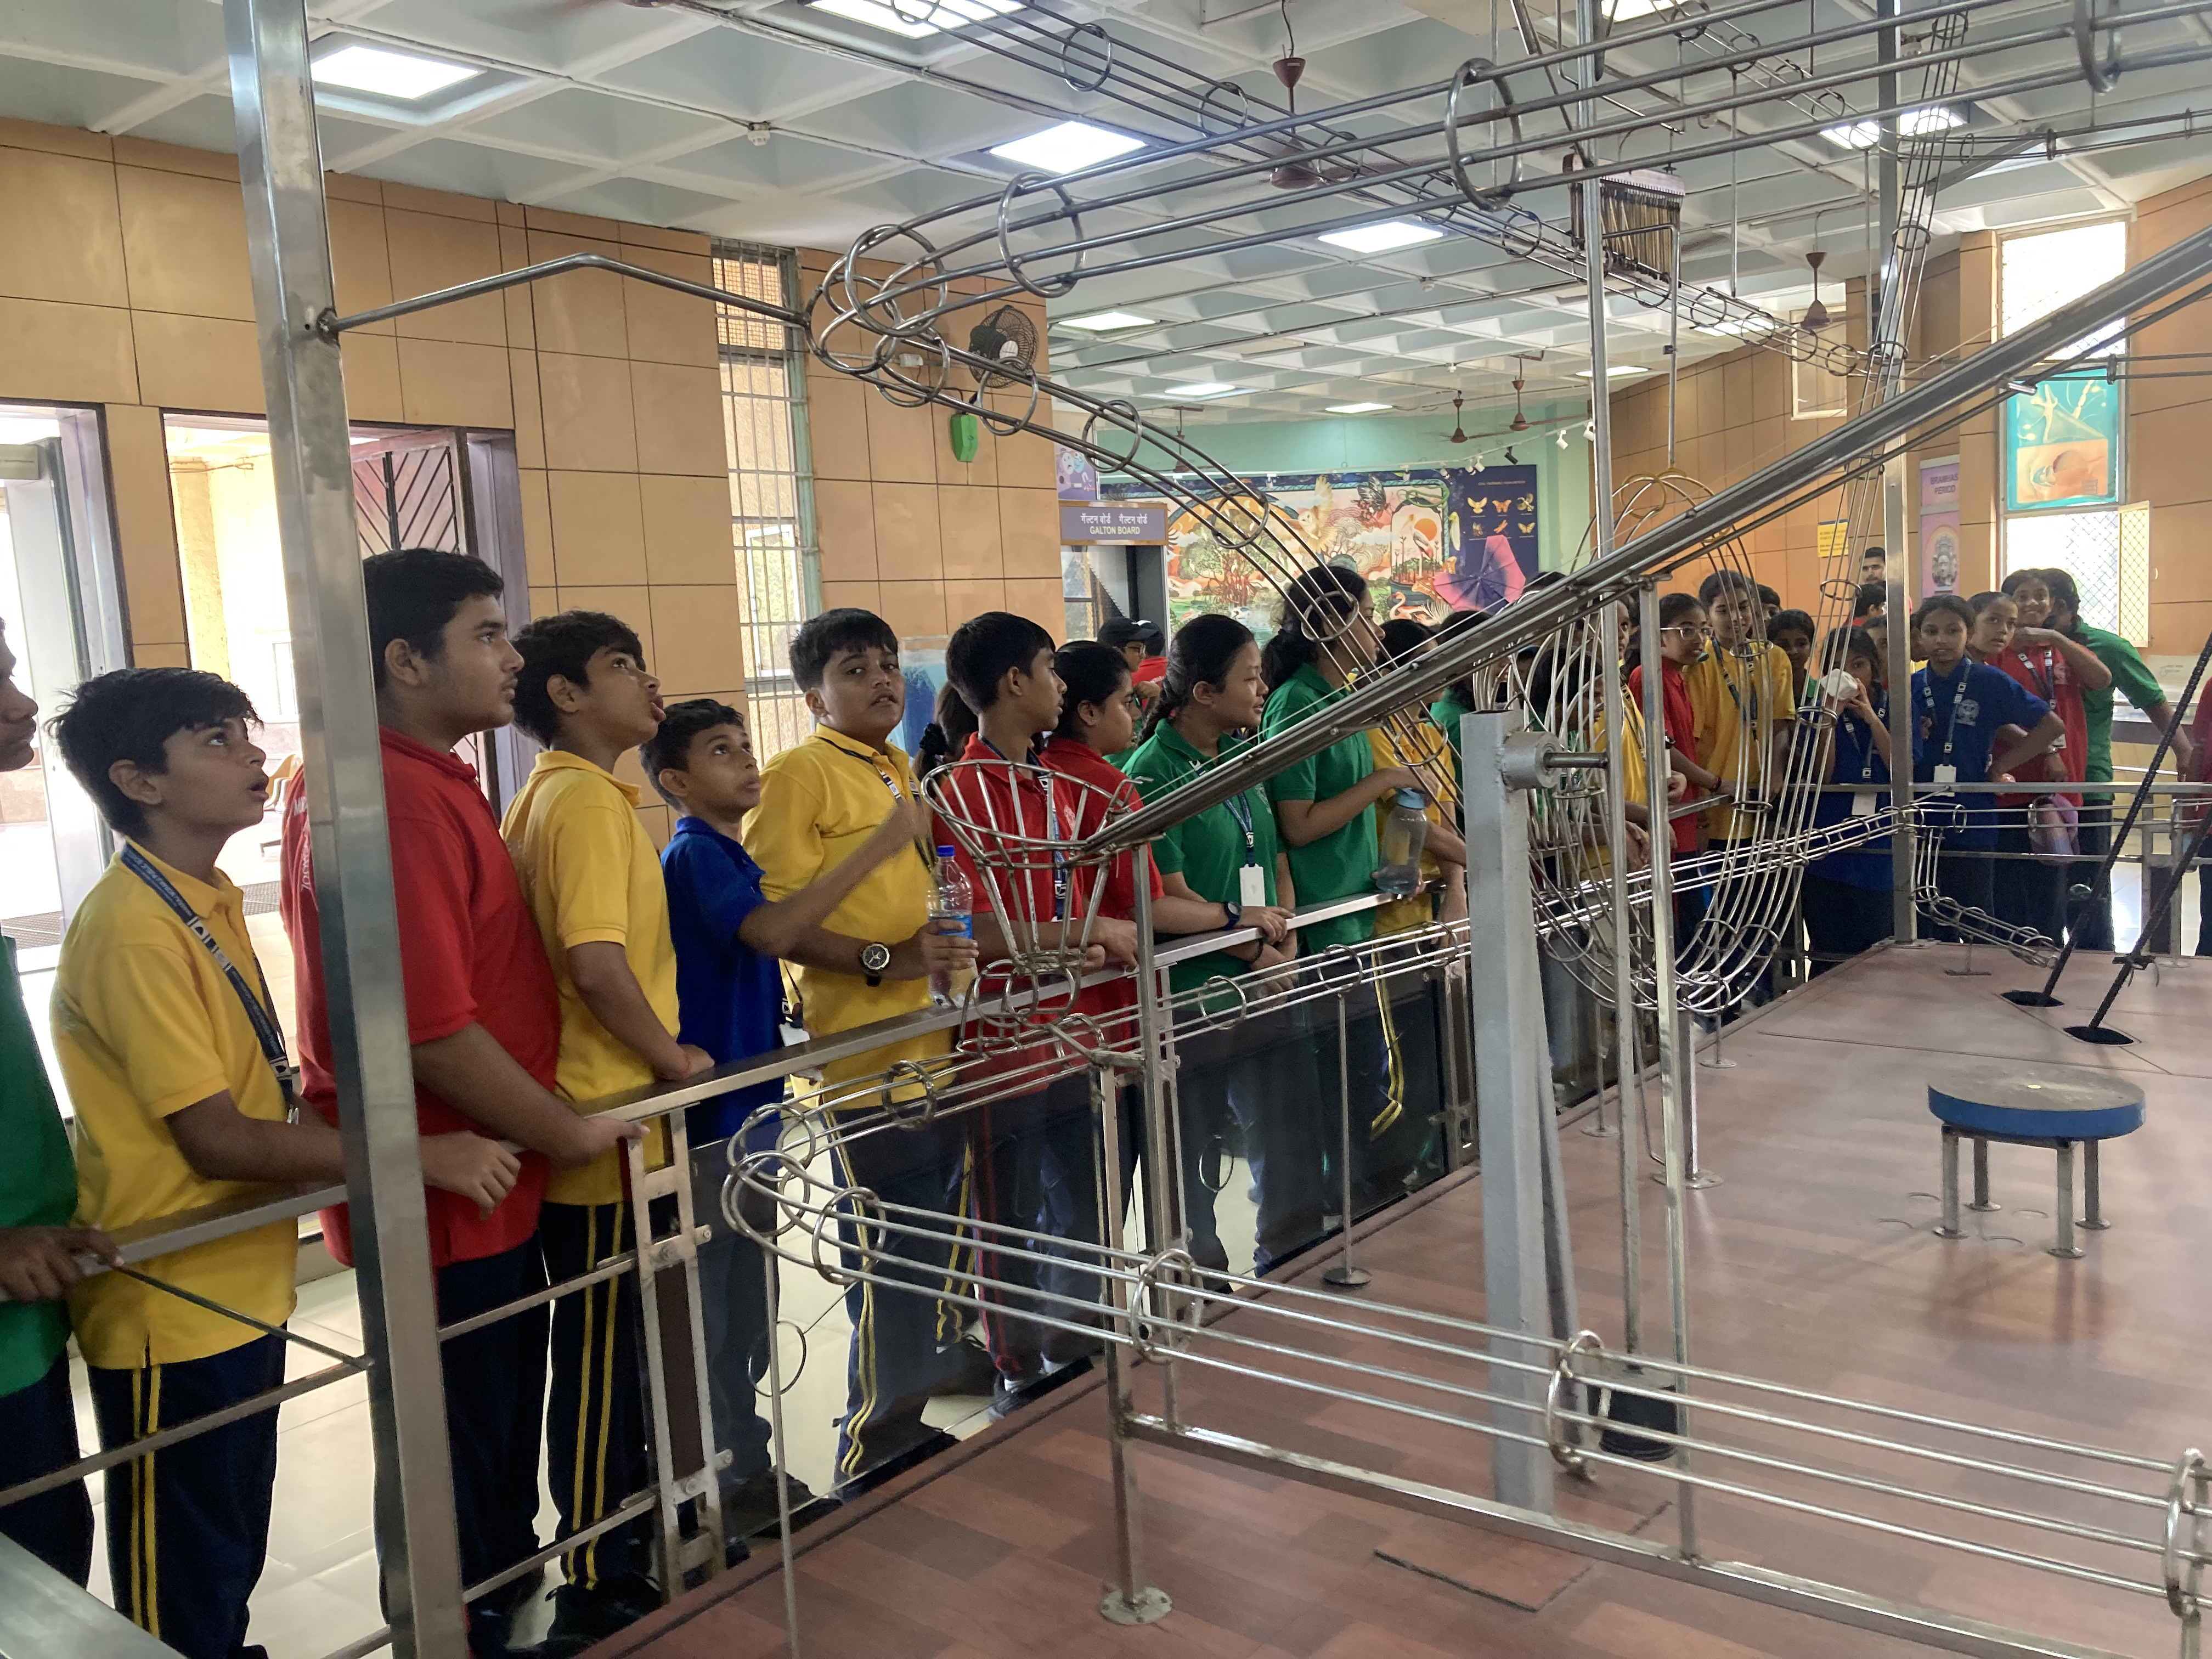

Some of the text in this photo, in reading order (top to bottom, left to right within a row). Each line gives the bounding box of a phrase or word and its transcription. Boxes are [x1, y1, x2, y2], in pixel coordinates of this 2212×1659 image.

[1934, 485, 1956, 494] PERIOD
[1099, 512, 1111, 524] बोर्ड
[1136, 513, 1148, 524] बोर्ड
[1090, 526, 1141, 534] GALTON BOARD
